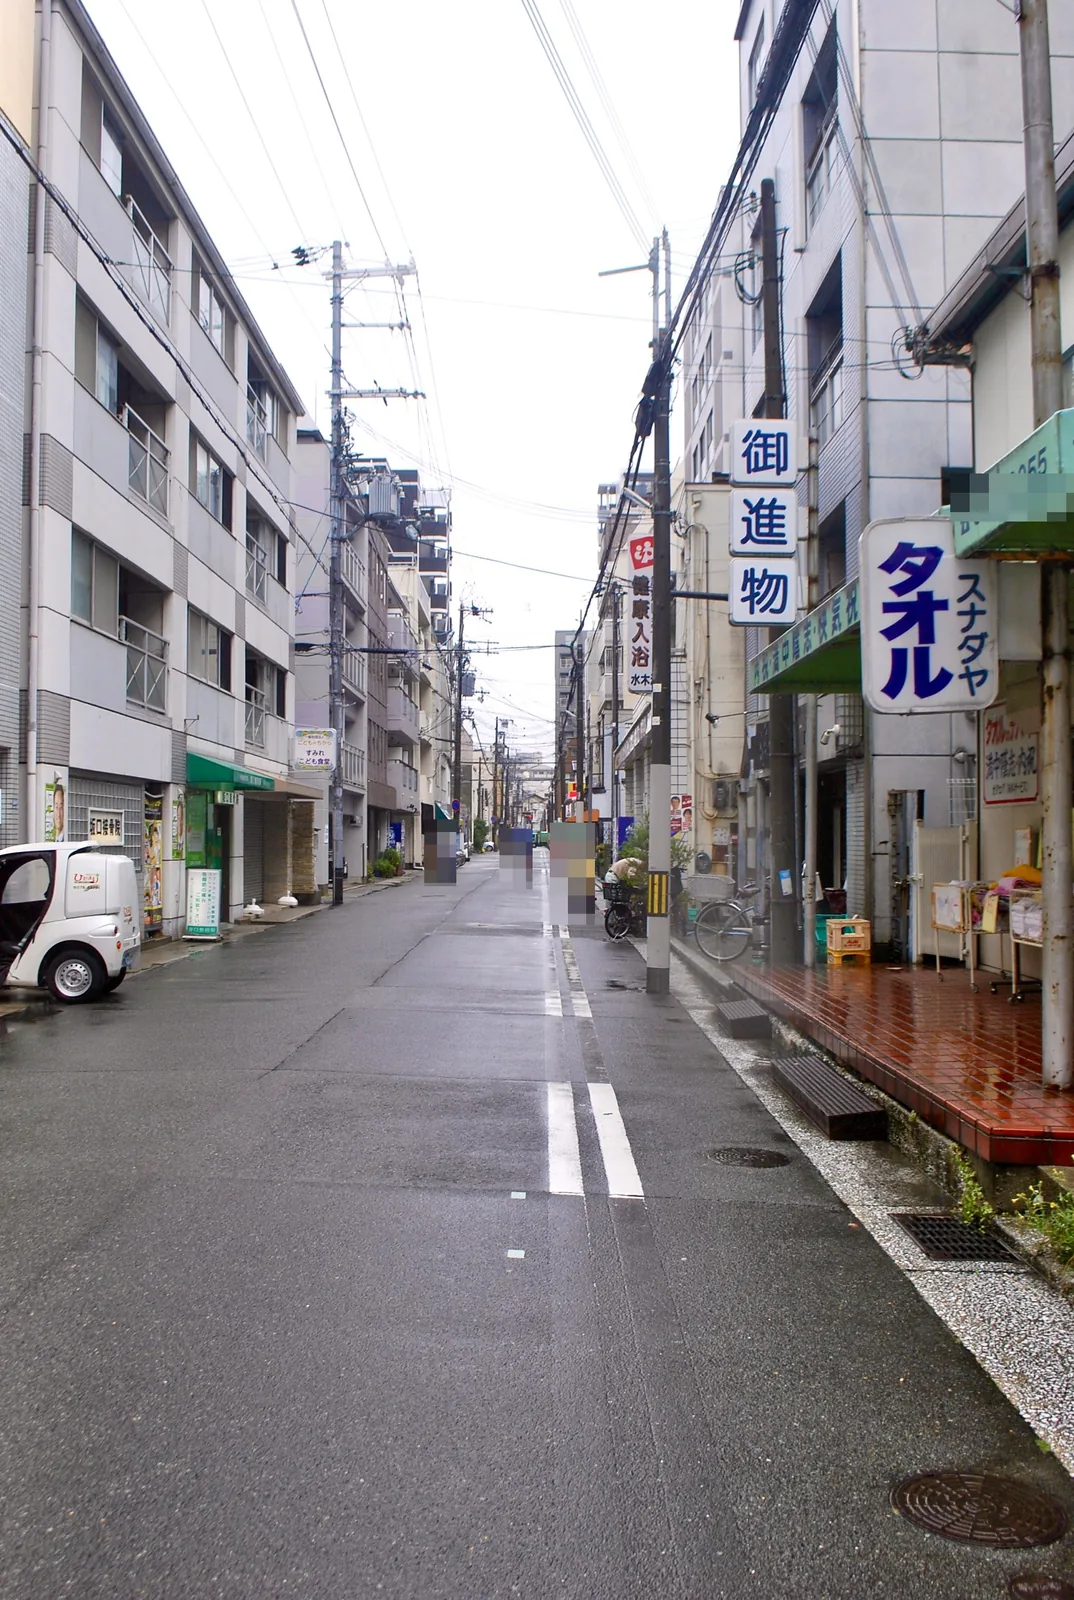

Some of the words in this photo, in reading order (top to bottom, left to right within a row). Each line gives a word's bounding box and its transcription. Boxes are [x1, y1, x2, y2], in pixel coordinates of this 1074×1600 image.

[741, 429, 788, 615] 御進物
[630, 674, 653, 686] 水木
[631, 575, 650, 667] 健康入浴
[877, 541, 954, 700] タオル
[956, 573, 989, 696] スナダヤ
